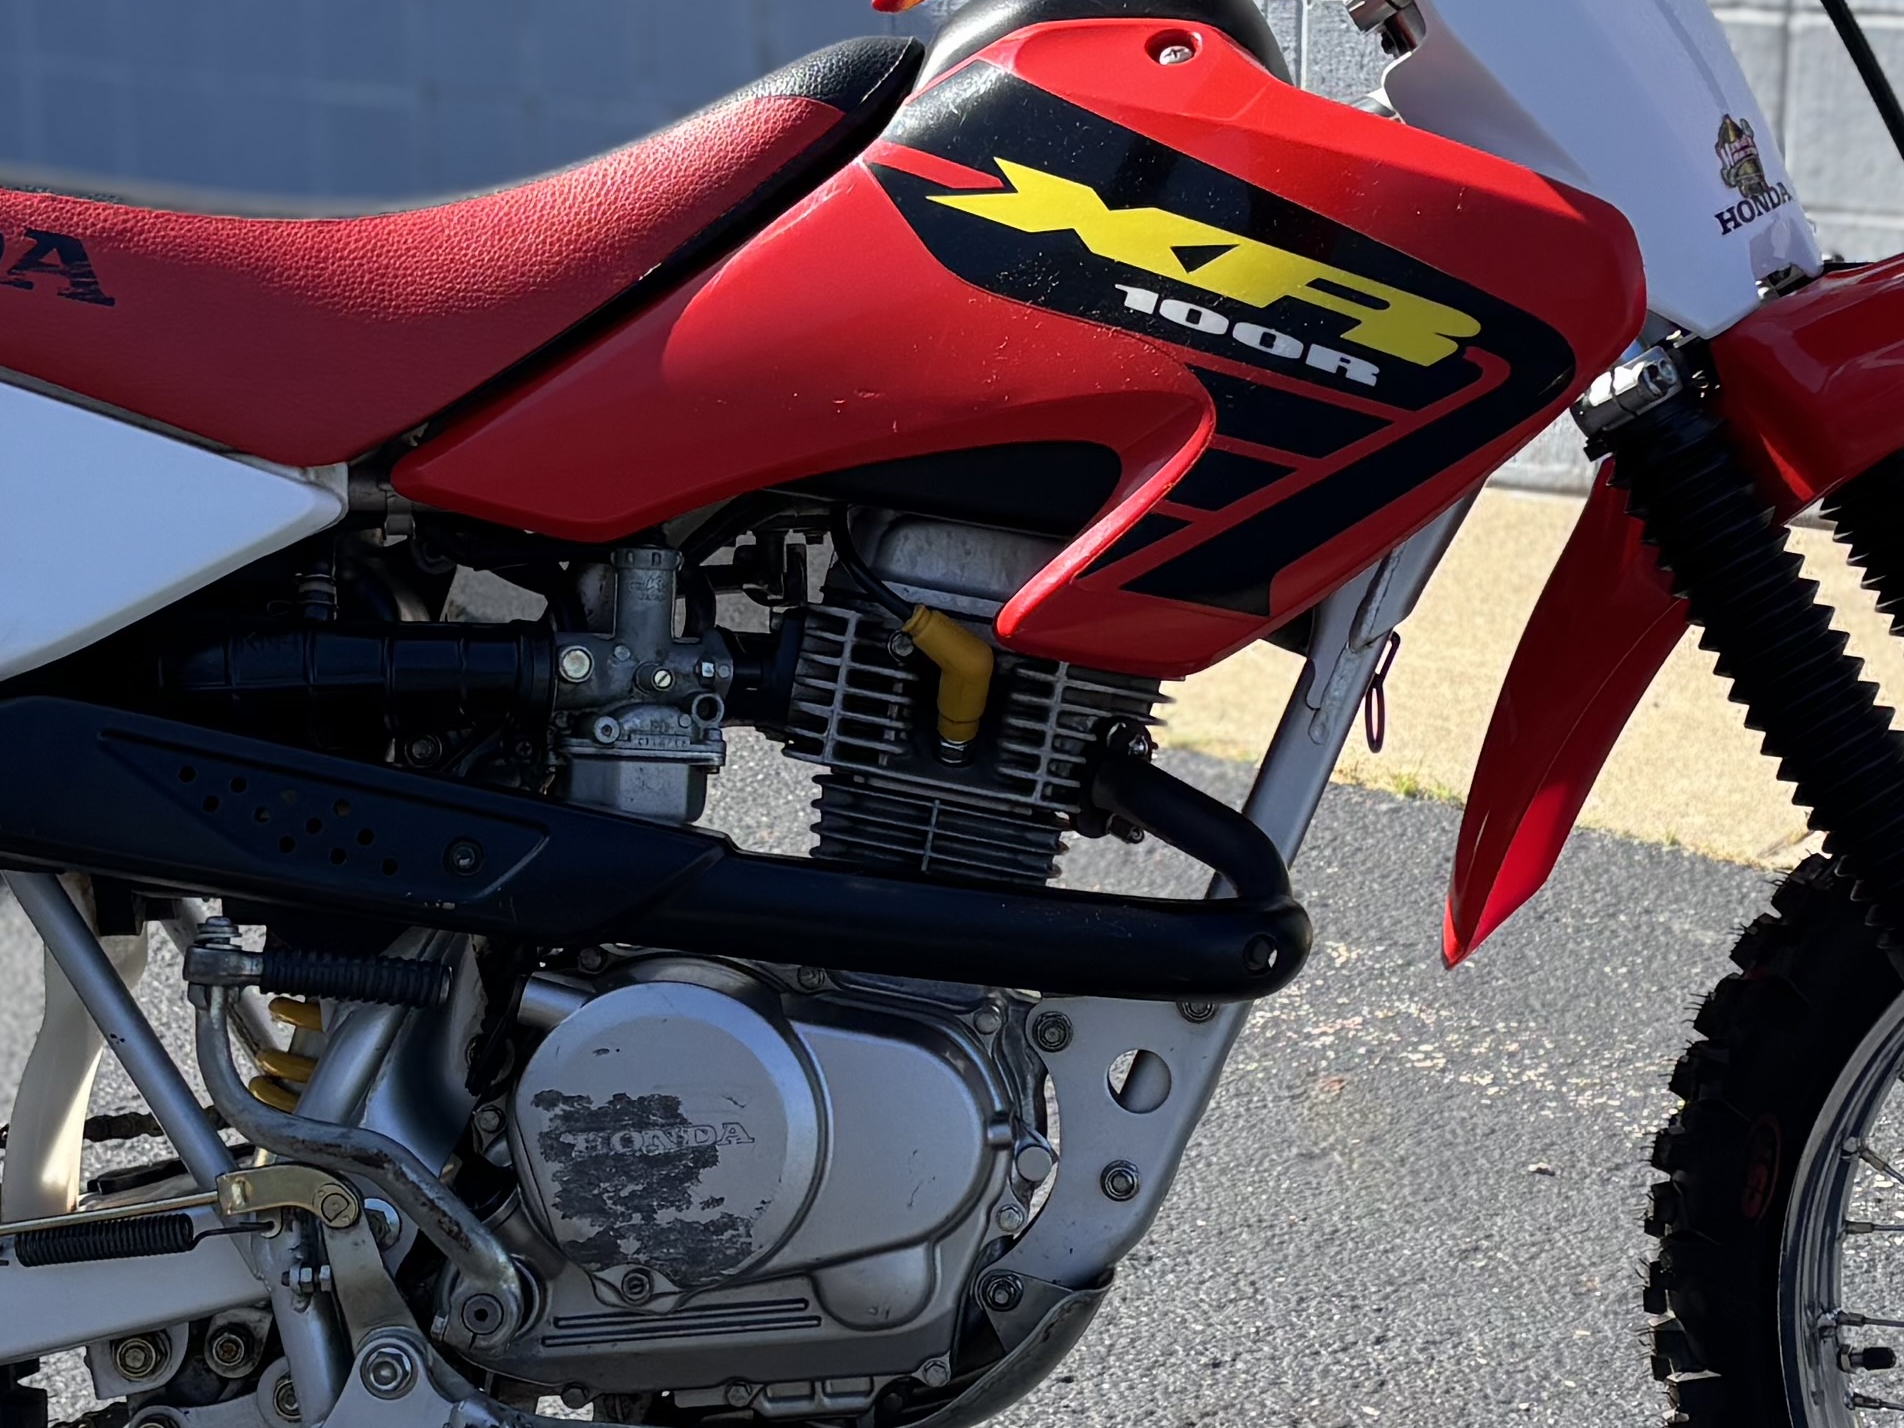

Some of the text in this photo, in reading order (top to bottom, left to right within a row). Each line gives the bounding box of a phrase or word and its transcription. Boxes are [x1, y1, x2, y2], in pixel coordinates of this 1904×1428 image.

[1715, 182, 1793, 235] HONDA
[925, 157, 1481, 366] XR
[1115, 283, 1380, 386] 100R
